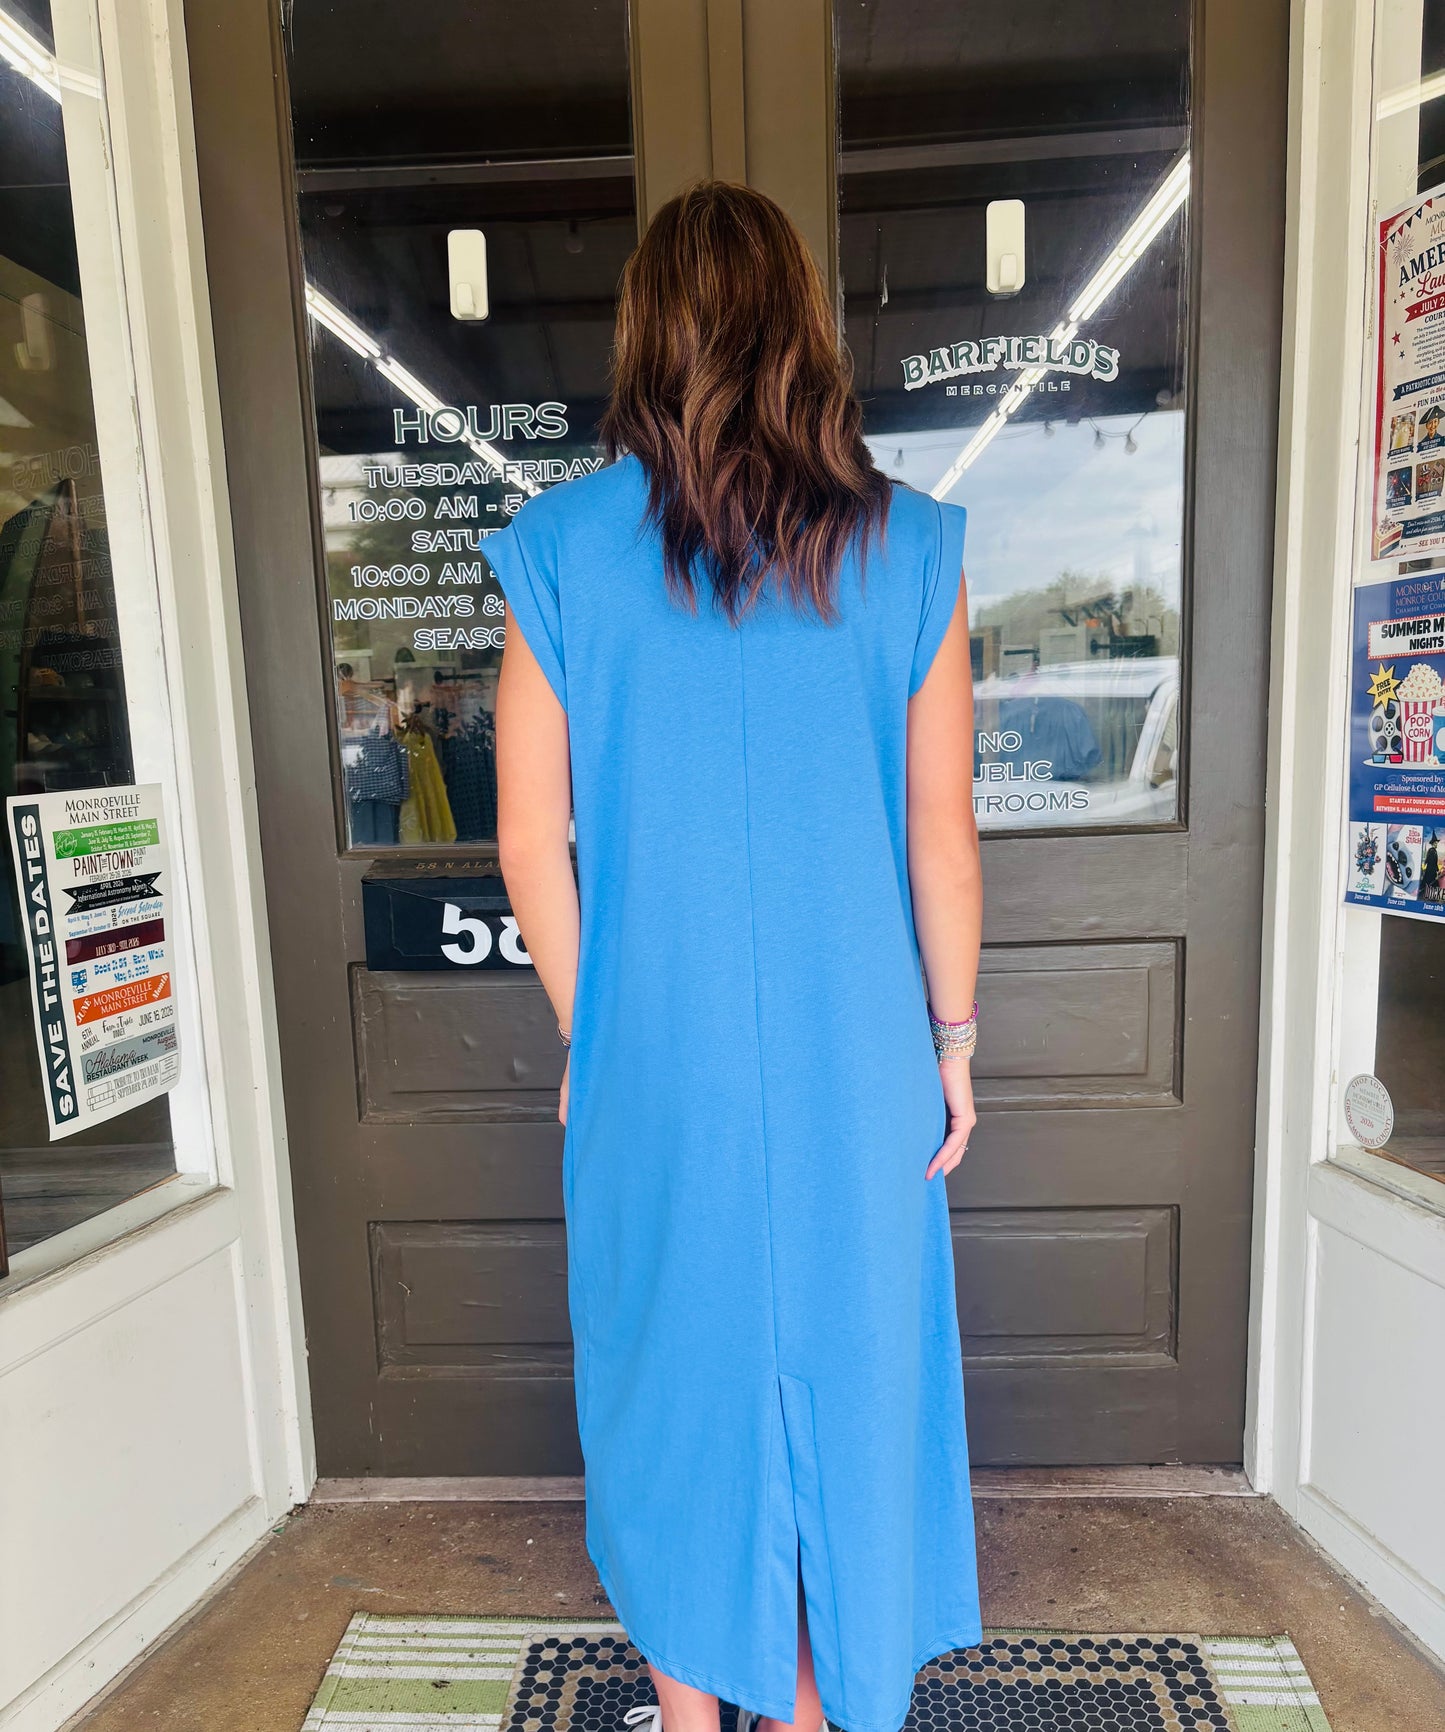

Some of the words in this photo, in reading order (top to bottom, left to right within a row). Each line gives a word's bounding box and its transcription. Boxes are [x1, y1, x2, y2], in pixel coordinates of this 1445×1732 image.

[1420, 298, 1439, 313] JULY
[946, 380, 1071, 396] MERCANTILE
[1417, 398, 1429, 408] FUN
[393, 402, 568, 444] HOURS
[363, 458, 604, 488] TUESDAY-FRIDAY
[348, 498, 426, 522] 10:00
[434, 496, 478, 519] AM
[504, 493, 526, 516] 5
[351, 563, 430, 588] 10:00
[438, 562, 482, 585] AM
[333, 595, 475, 621] MONDAYS
[482, 593, 505, 616] &
[1381, 618, 1431, 639] SUMMER
[1409, 635, 1444, 651] NIGHTS
[1376, 677, 1391, 691] FREE
[1377, 686, 1392, 698] ENTRY
[1408, 726, 1431, 738] CORN
[1410, 715, 1431, 728] POP
[978, 731, 1023, 753] NO
[1401, 774, 1434, 784] Sponsored
[65, 793, 141, 812] MONROEVILLE
[972, 789, 1090, 814] TROOMS
[69, 811, 100, 824] MAIN
[103, 806, 139, 820] STREET
[133, 847, 147, 857] PAINT
[73, 854, 102, 877] PAINT
[105, 849, 134, 872] TOWN
[21, 814, 51, 936] DATES
[77, 891, 107, 903] International
[107, 886, 132, 898] Astronomy
[141, 911, 161, 921] SQUARE
[40, 940, 63, 1011] THE
[93, 980, 153, 1008] MONROEVILLE
[152, 973, 170, 1000] Month
[76, 997, 92, 1024] JUNE
[100, 1002, 122, 1015] MAIN
[123, 992, 148, 1007] STREET
[138, 1012, 153, 1027] JUNE
[81, 1026, 93, 1040] 6TH
[142, 1026, 175, 1044] MONROEVILLE
[48, 1020, 74, 1116] SAVE
[85, 1047, 138, 1075] Alabama
[86, 1061, 129, 1082] RESTAURANT
[130, 1053, 149, 1065] WEEK
